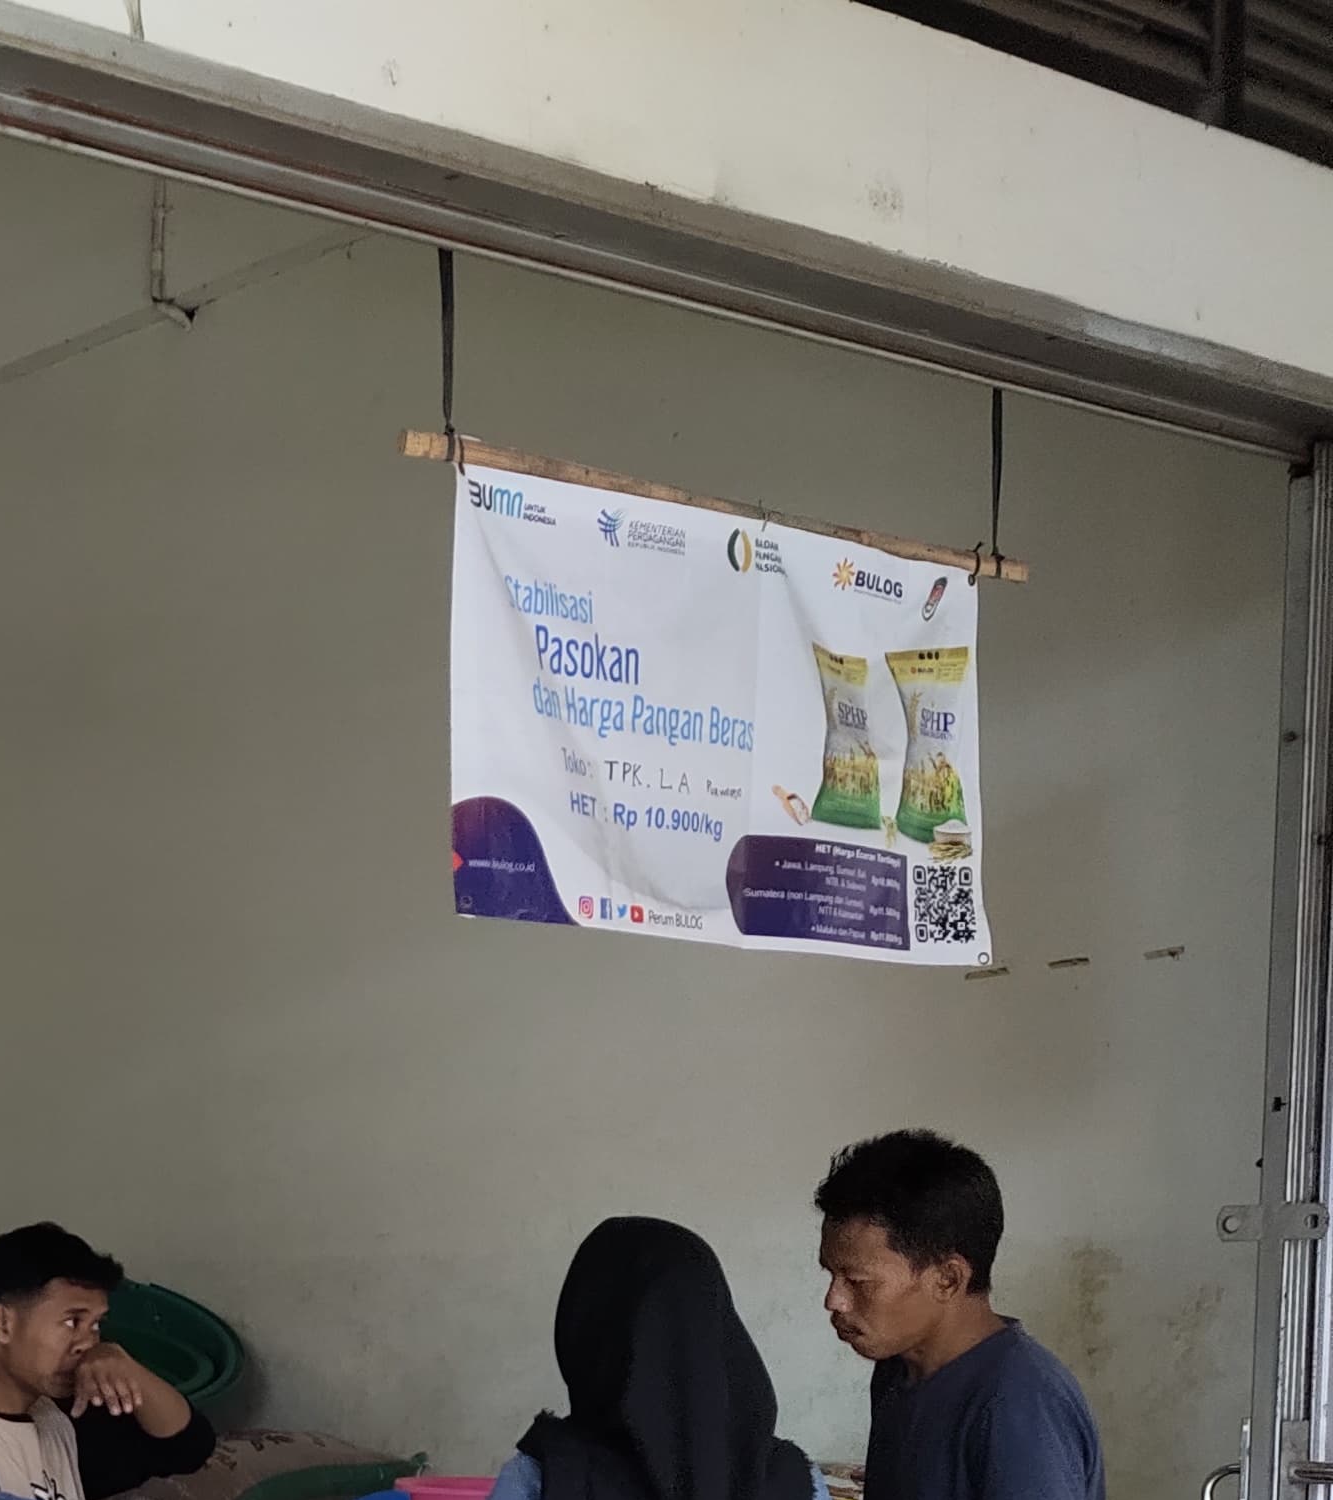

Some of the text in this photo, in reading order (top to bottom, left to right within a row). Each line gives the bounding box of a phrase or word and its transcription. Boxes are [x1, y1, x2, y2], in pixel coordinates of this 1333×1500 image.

[629, 520, 686, 538] KEMENTERIAN
[854, 570, 903, 598] BULOG
[504, 575, 593, 624] Stabilisasi
[535, 624, 640, 685] Pasokan
[533, 676, 755, 752] dan Harga Pangan Beras
[838, 702, 868, 726] SPHP
[921, 708, 956, 733] SPHP
[613, 803, 638, 831] Rp
[645, 806, 723, 842] 10.900/kg
[648, 911, 703, 930] Perum BULOG
